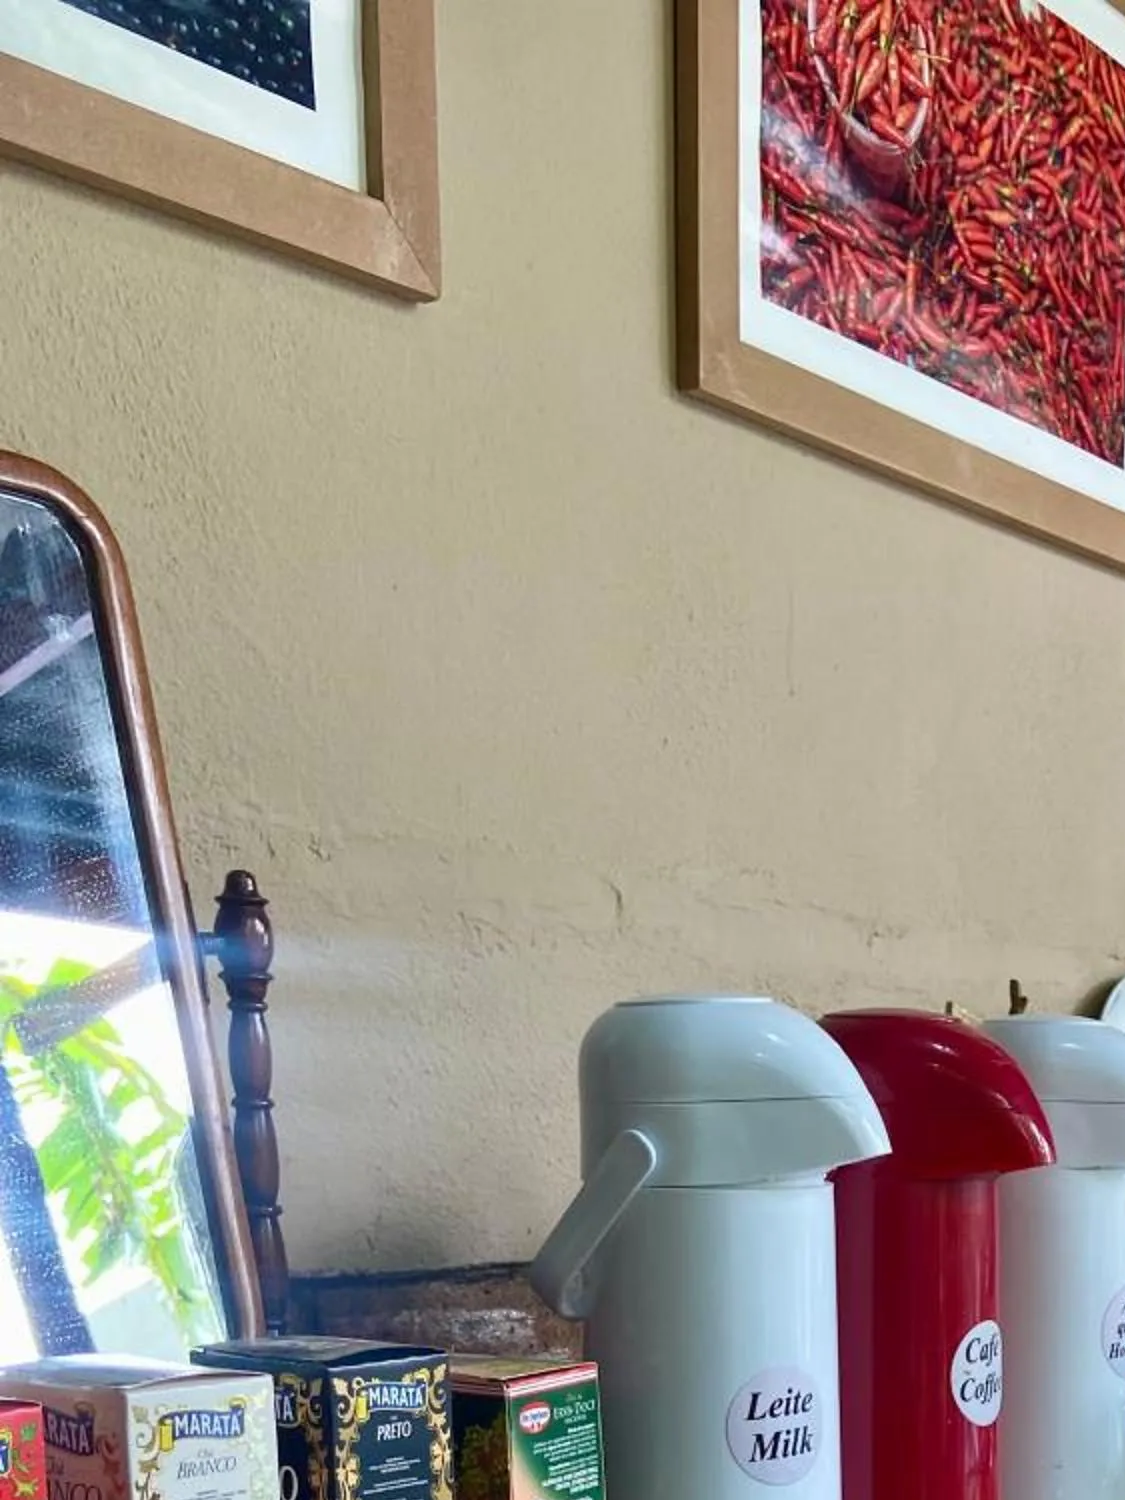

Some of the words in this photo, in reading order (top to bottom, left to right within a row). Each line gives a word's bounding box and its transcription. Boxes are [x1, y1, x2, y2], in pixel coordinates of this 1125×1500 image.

[745, 1387, 814, 1421] Leite
[46, 1411, 93, 1453] RATÁ
[377, 1421, 412, 1441] PRETO
[748, 1425, 814, 1462] Milk
[176, 1455, 237, 1479] BRANCO
